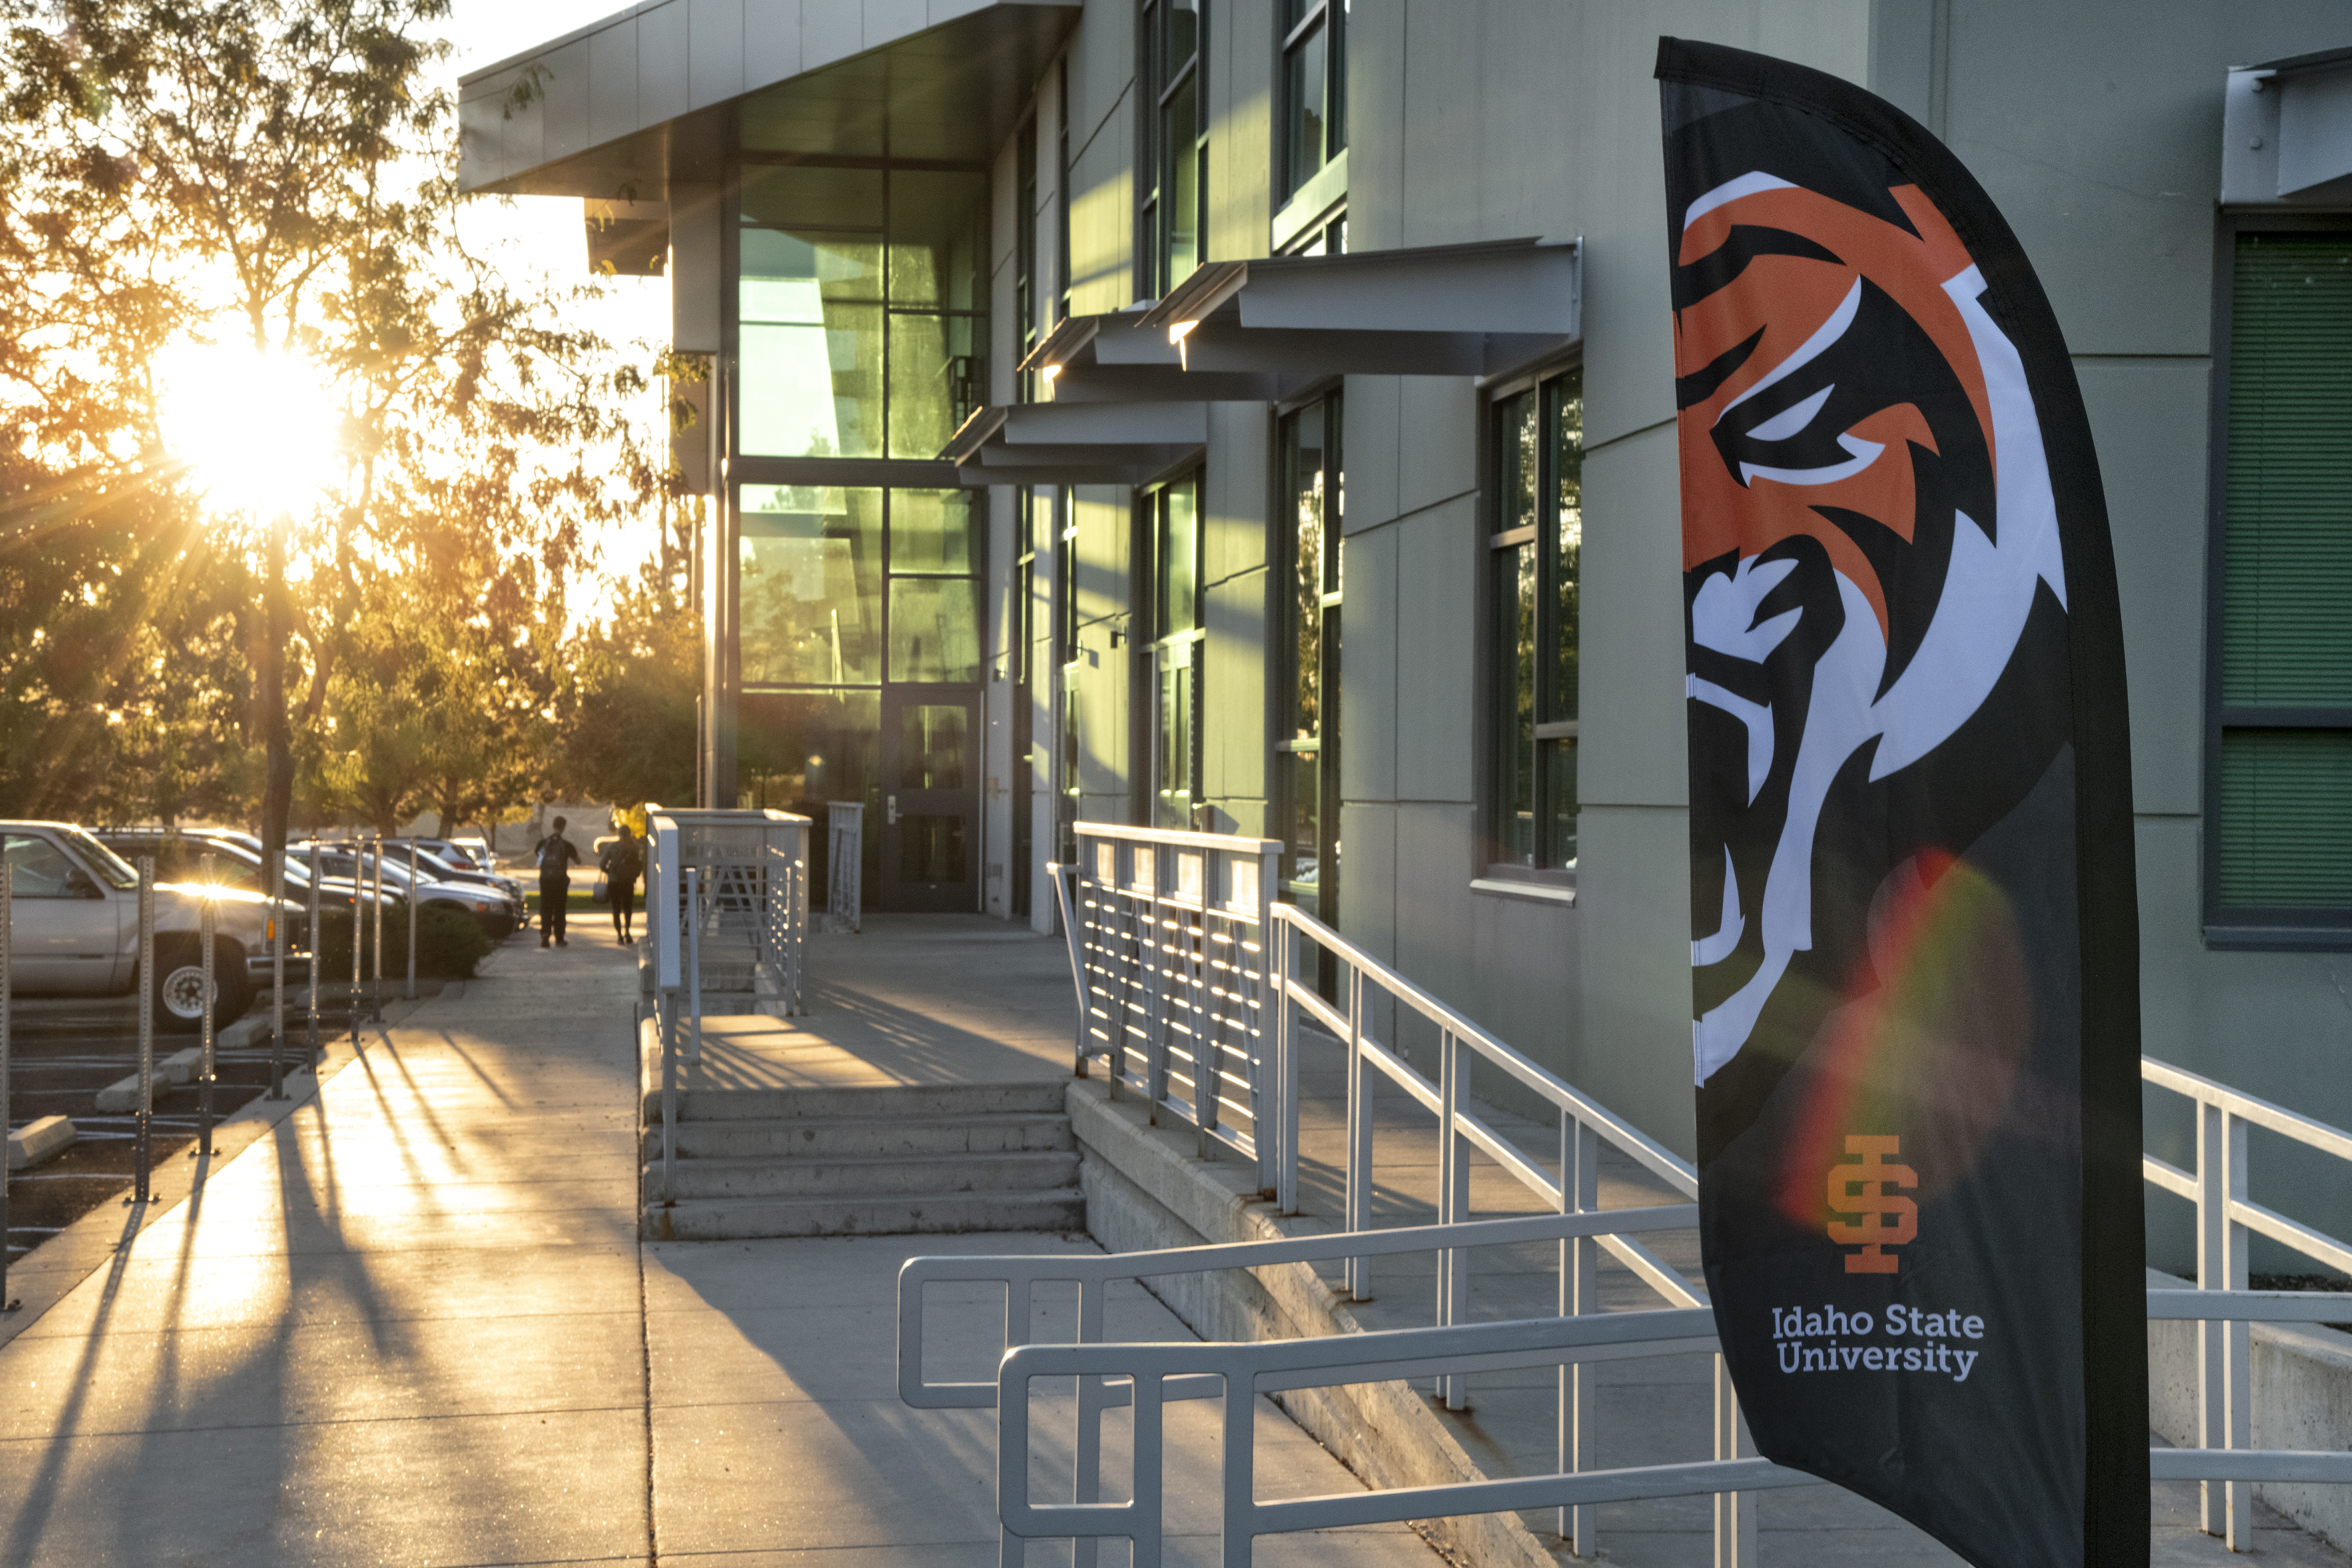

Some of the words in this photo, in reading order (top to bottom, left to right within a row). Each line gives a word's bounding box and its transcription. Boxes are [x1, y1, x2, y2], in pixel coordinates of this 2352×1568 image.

[1772, 1304, 1874, 1339] Idaho
[1885, 1304, 1985, 1339] State
[1777, 1340, 1979, 1382] University
